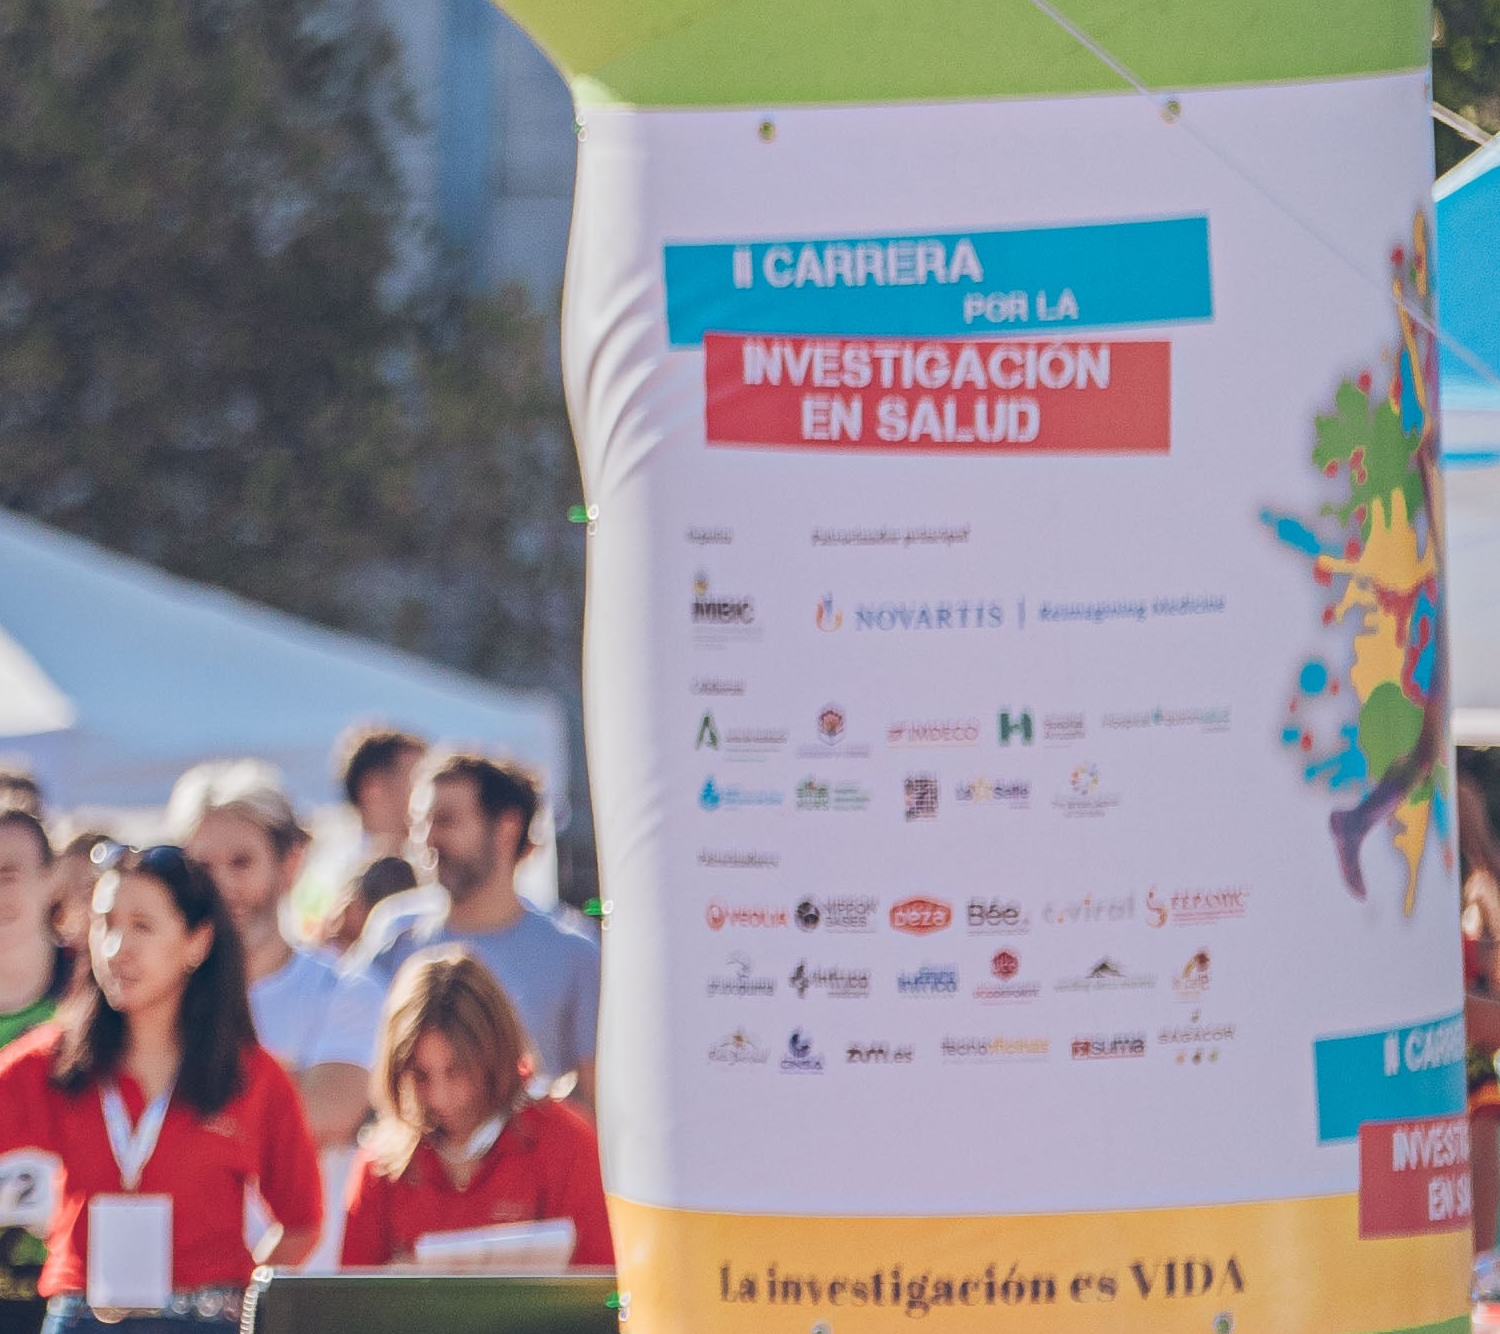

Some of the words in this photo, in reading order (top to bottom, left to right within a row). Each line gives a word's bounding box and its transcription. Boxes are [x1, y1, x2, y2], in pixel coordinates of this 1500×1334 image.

[762, 238, 984, 288] CARRERA
[963, 289, 1029, 325] POR
[1036, 287, 1080, 321] LA
[742, 340, 1112, 390] INVESTIGACIÓN
[801, 393, 863, 441] EN
[876, 394, 1041, 443] SALUD
[854, 600, 1004, 631] NOVARTIS
[719, 1261, 757, 1305] La
[766, 1261, 1056, 1320] investigación
[1070, 1270, 1117, 1304] es
[1128, 1256, 1247, 1300] VIDA
